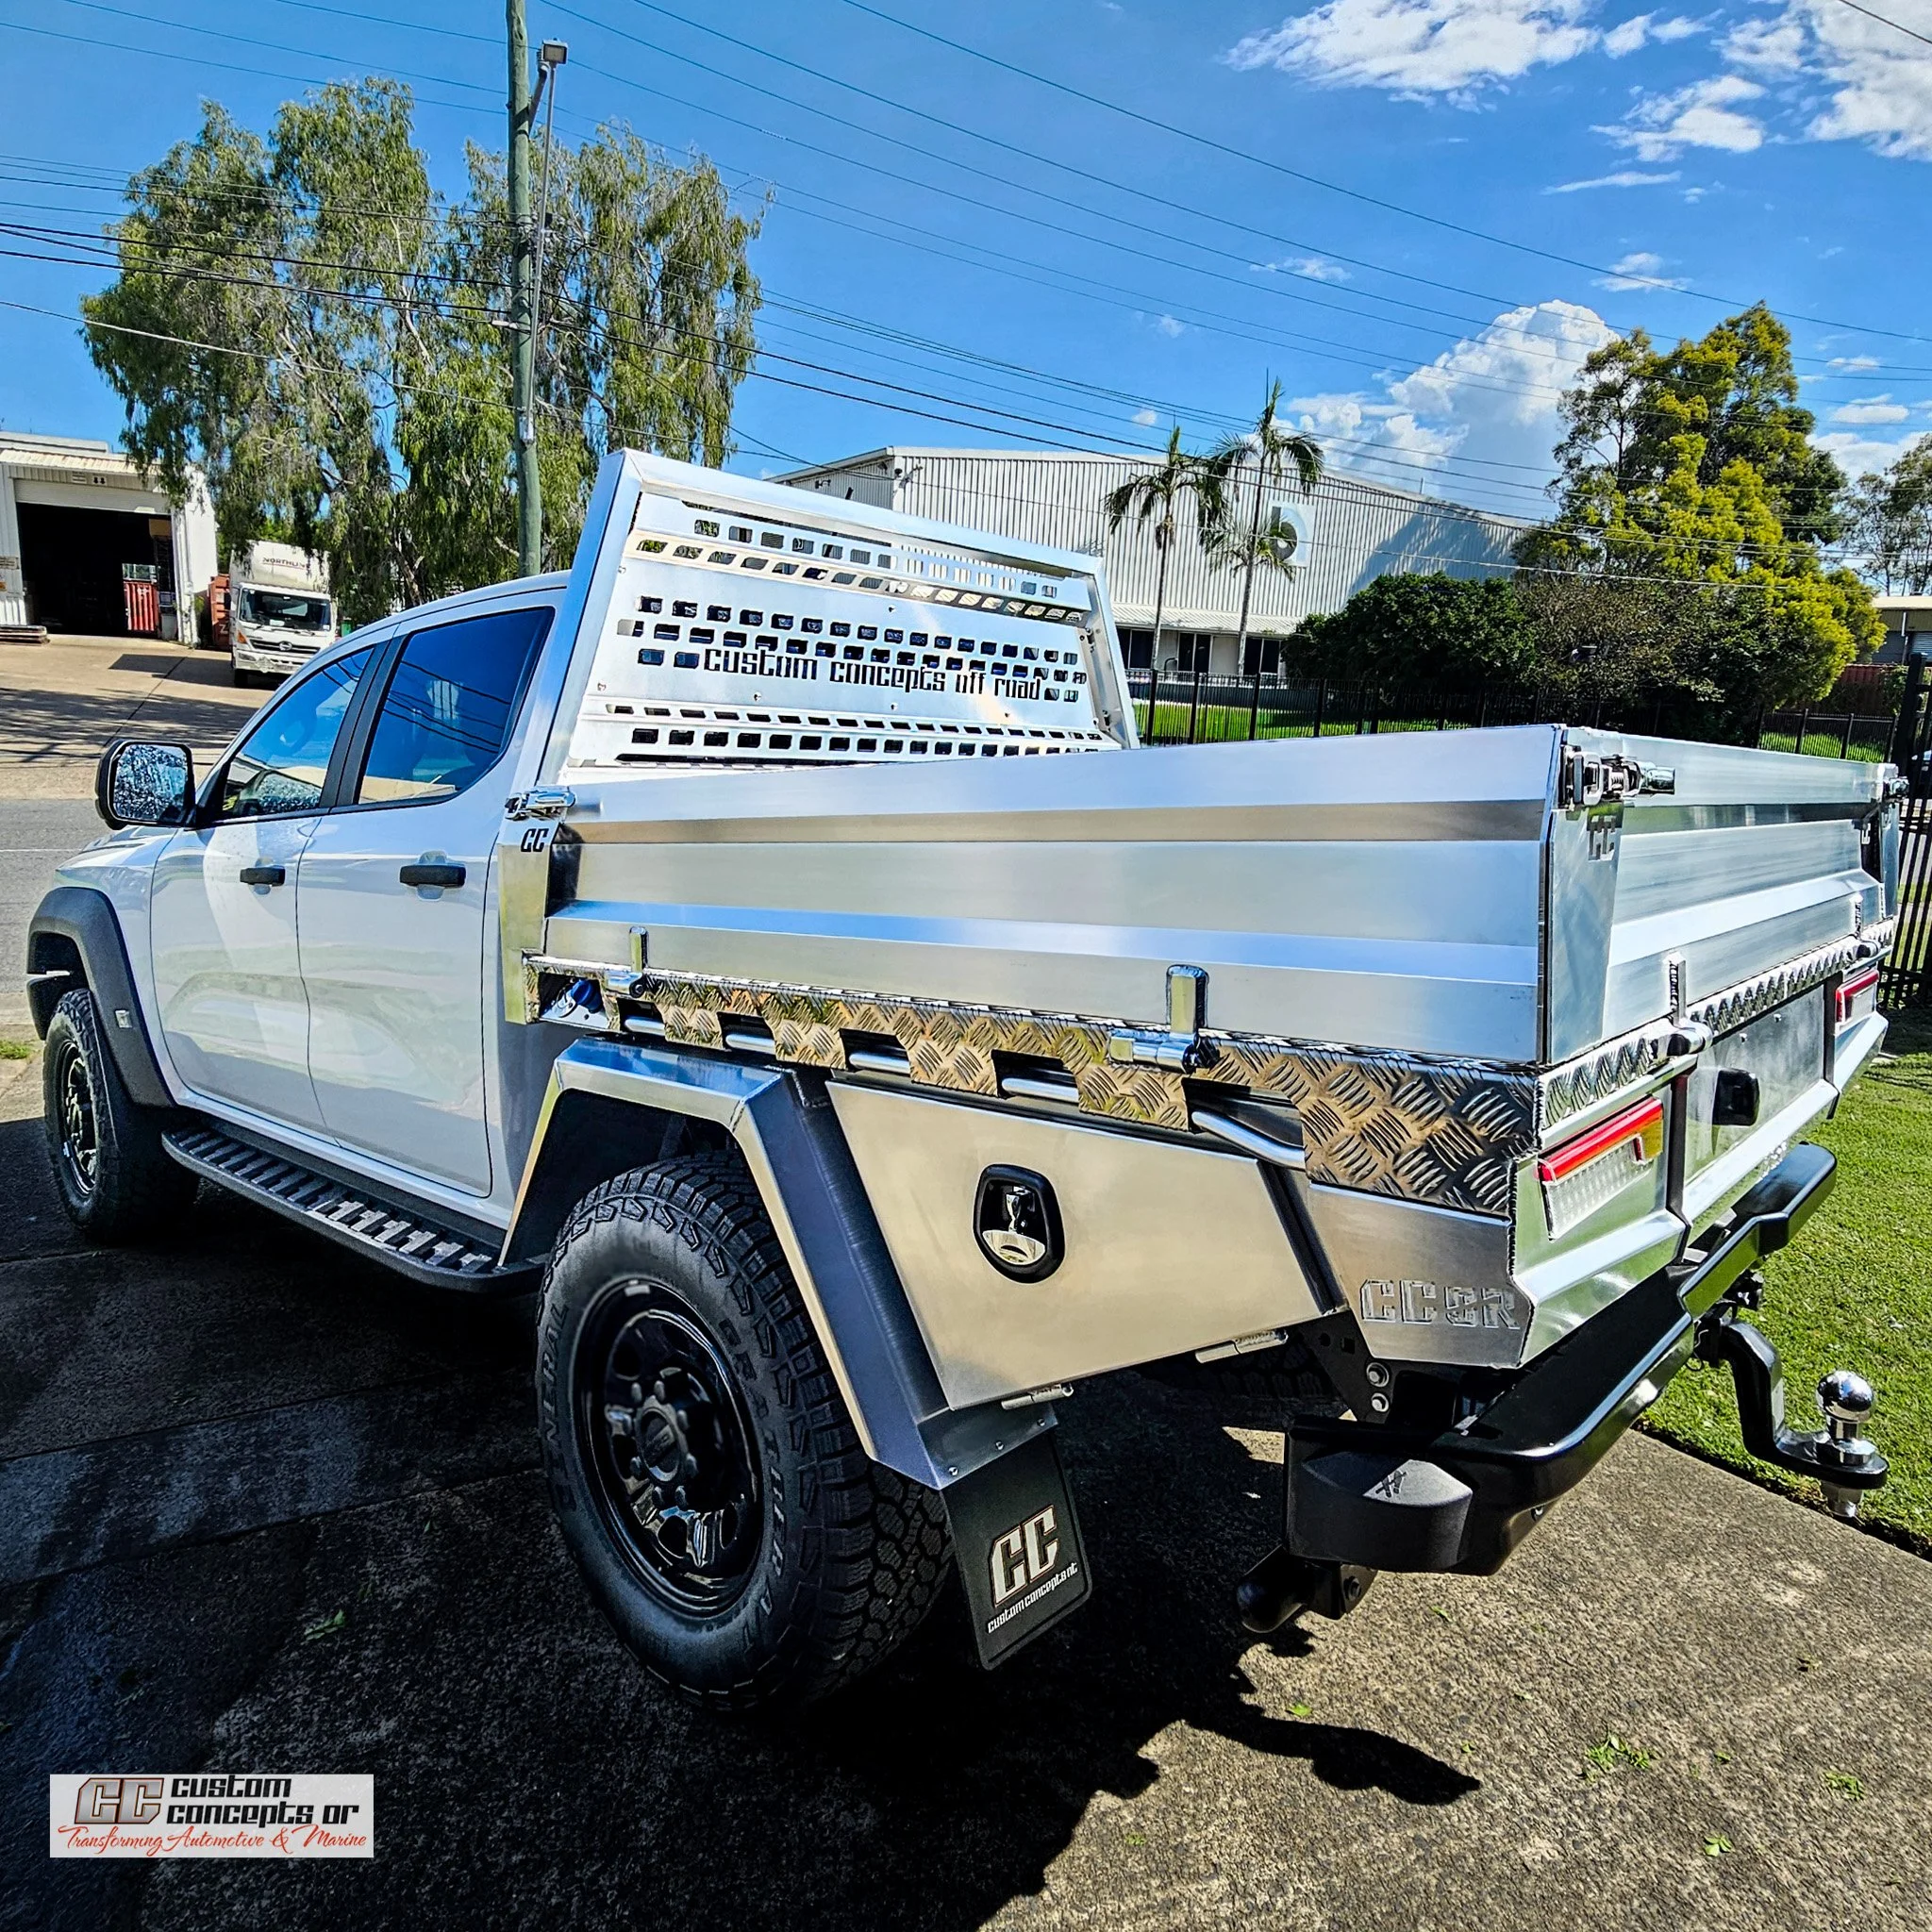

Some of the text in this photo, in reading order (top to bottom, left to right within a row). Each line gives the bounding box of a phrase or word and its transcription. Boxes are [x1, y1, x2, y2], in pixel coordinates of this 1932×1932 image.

[704, 646, 1041, 700] custom concepts off road
[521, 827, 550, 853] CC
[541, 1303, 578, 1512] GENERAL
[991, 1504, 1059, 1608] CC
[987, 1600, 1025, 1634] custom
